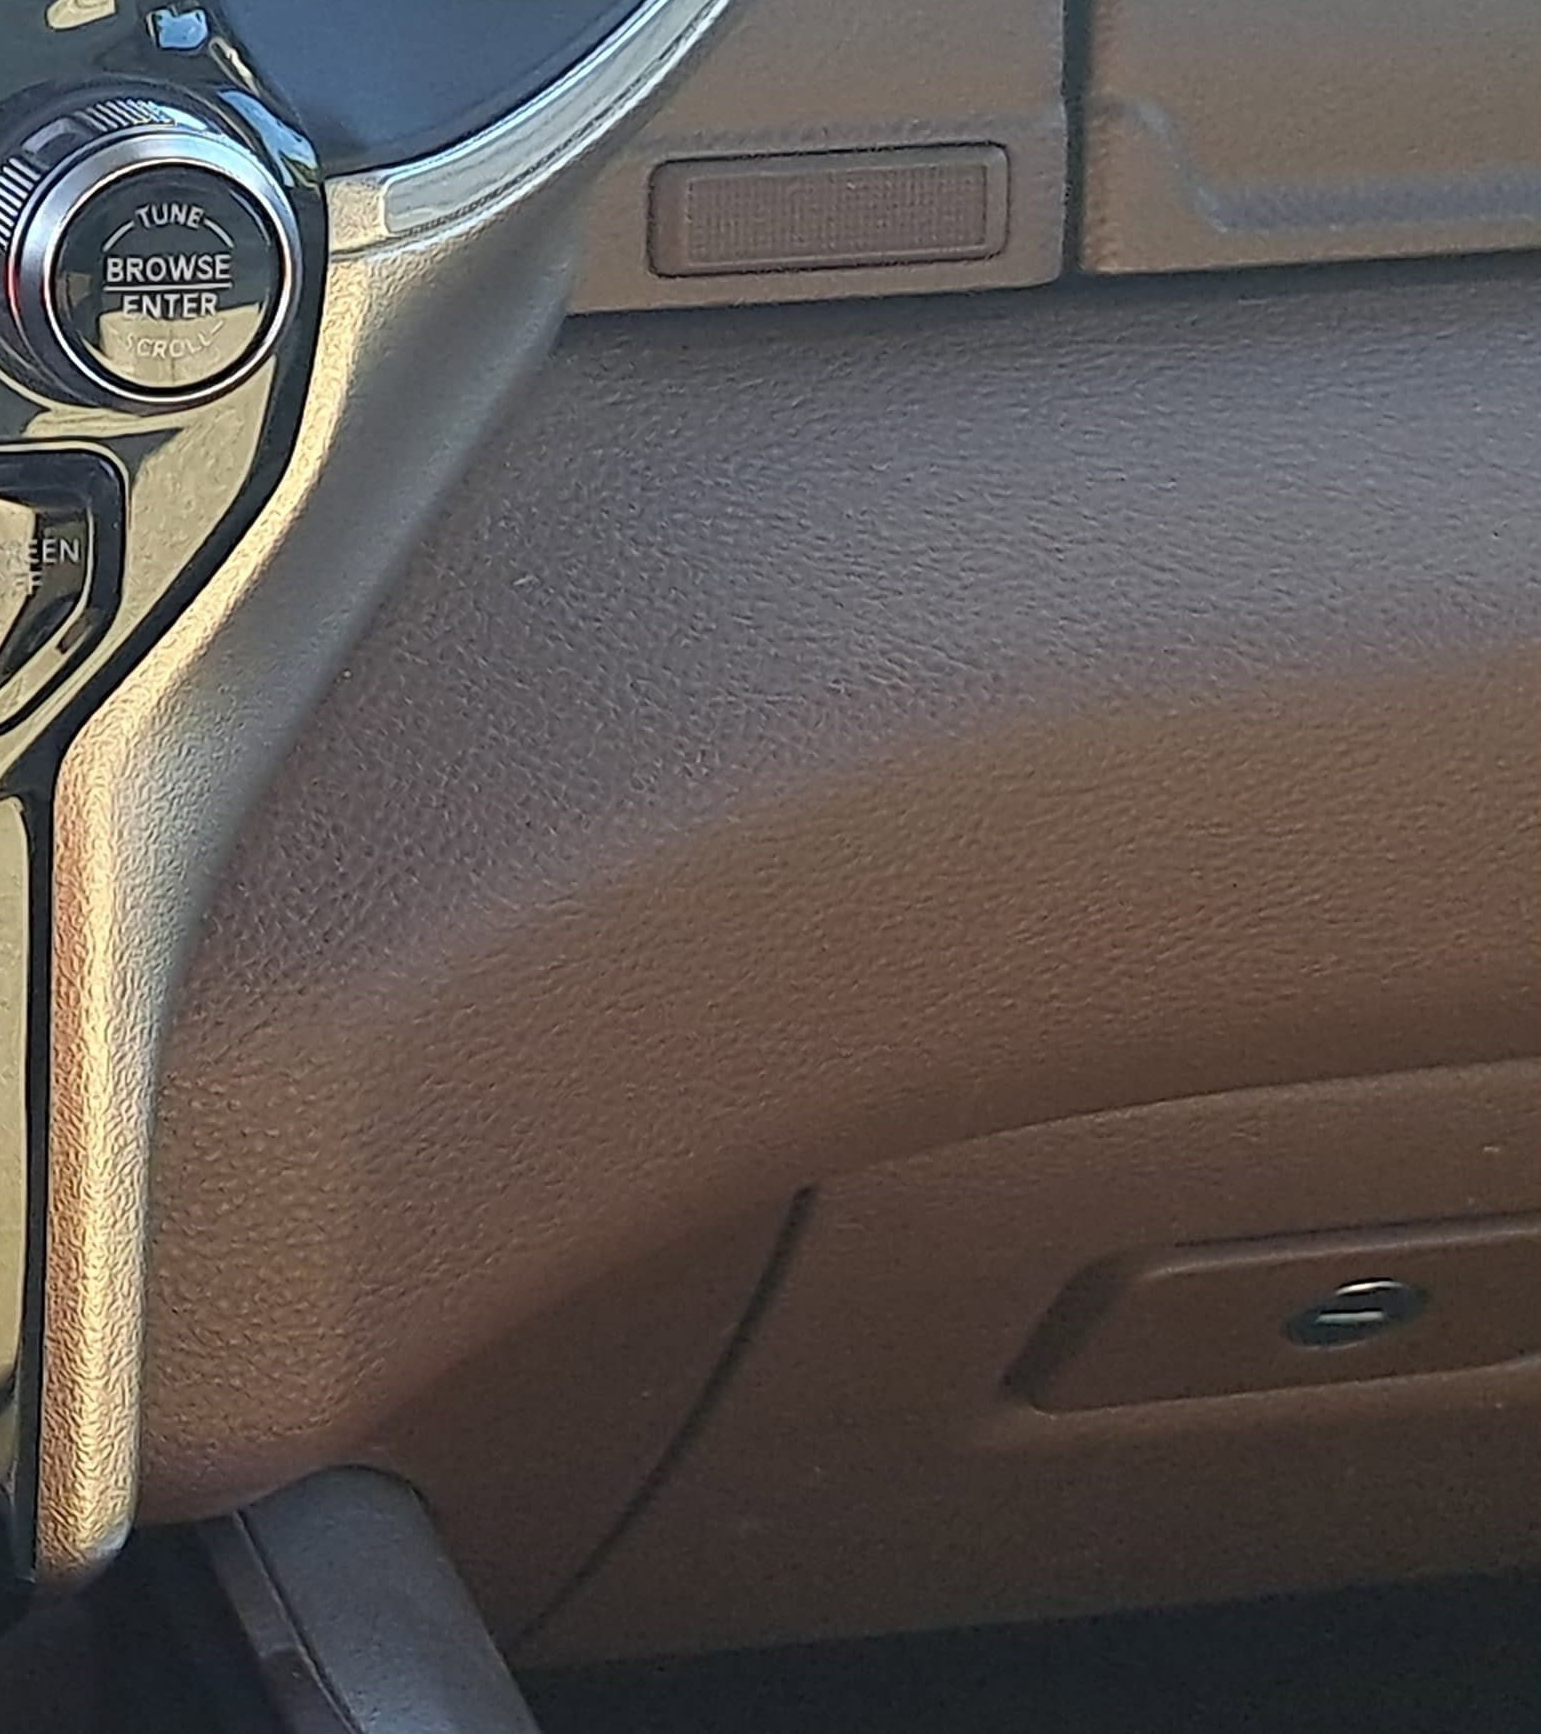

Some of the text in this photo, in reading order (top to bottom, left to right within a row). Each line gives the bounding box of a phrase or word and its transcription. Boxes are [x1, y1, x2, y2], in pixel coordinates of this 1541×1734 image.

[134, 203, 205, 230] TUNE
[106, 253, 233, 283] BROWSE
[122, 292, 218, 319] ENTER
